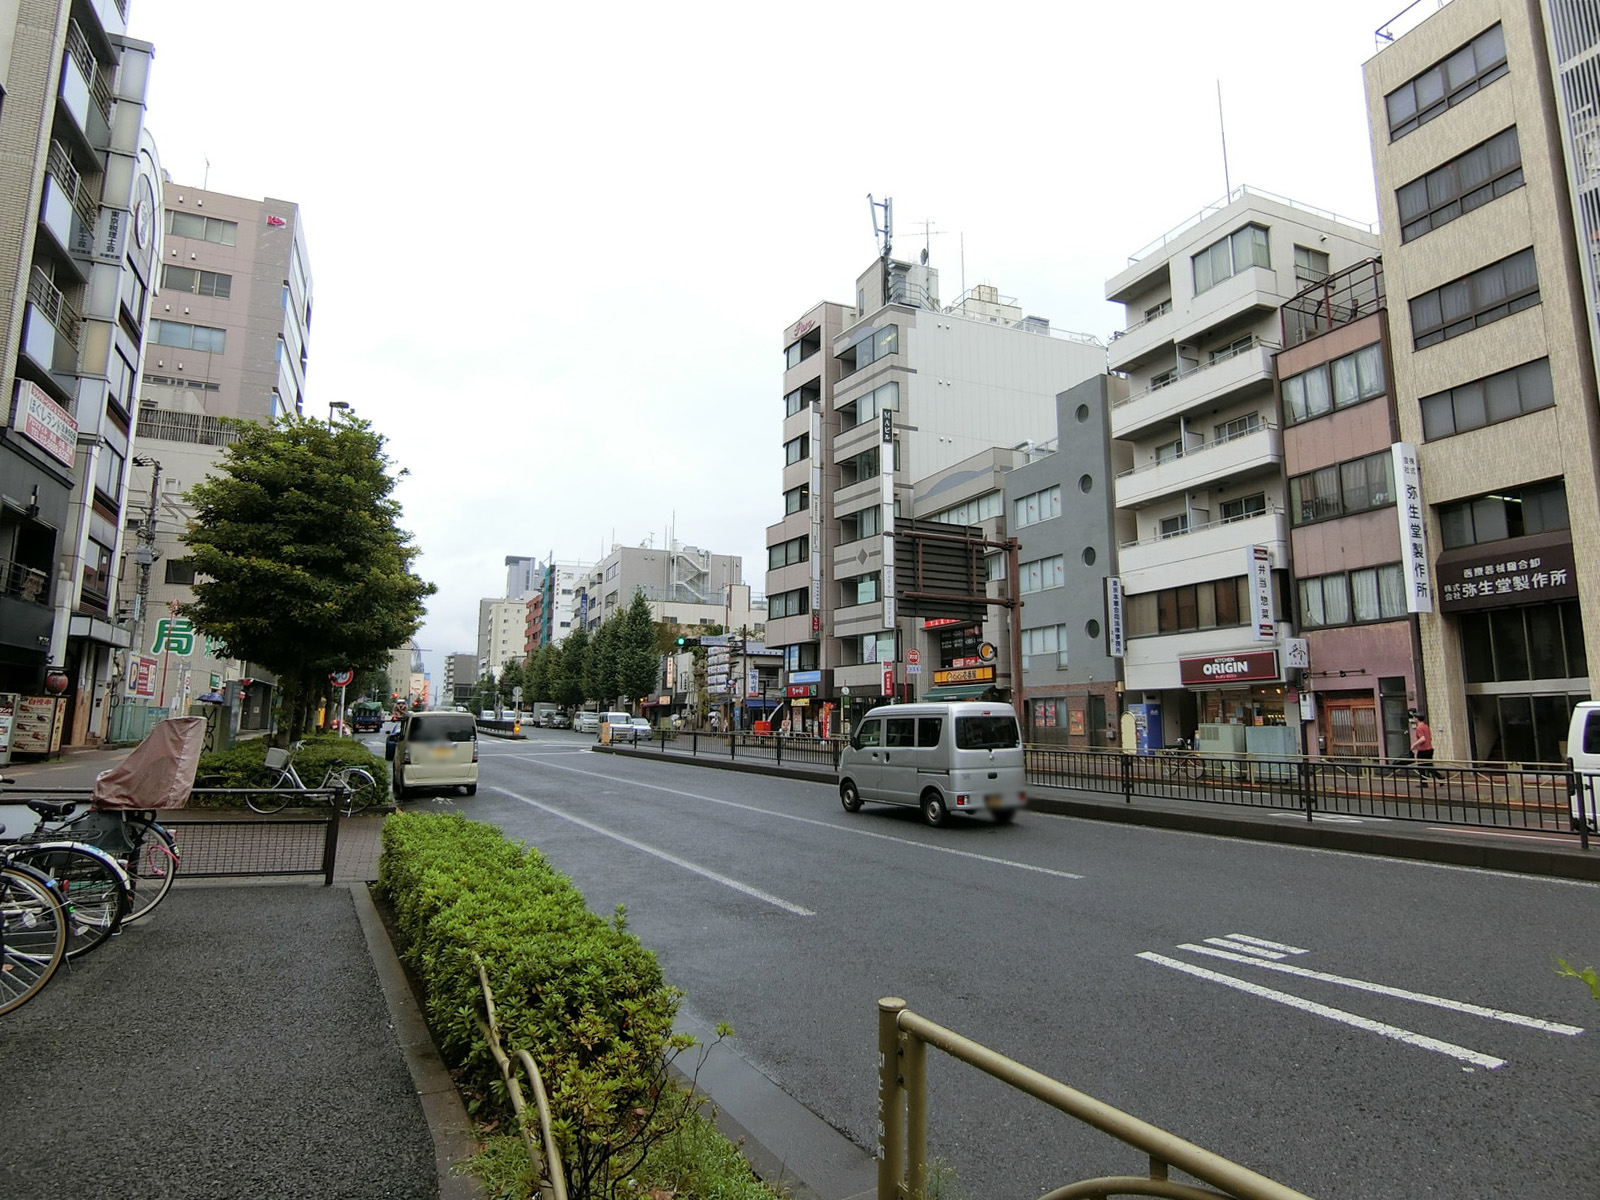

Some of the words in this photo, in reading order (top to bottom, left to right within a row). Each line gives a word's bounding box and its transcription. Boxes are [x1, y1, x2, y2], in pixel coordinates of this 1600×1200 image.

[1406, 484, 1428, 598] 弥生堂製作所
[1462, 569, 1567, 598] 弥生堂製作所
[151, 618, 194, 657] 局
[1202, 661, 1249, 675] ORIGIN
